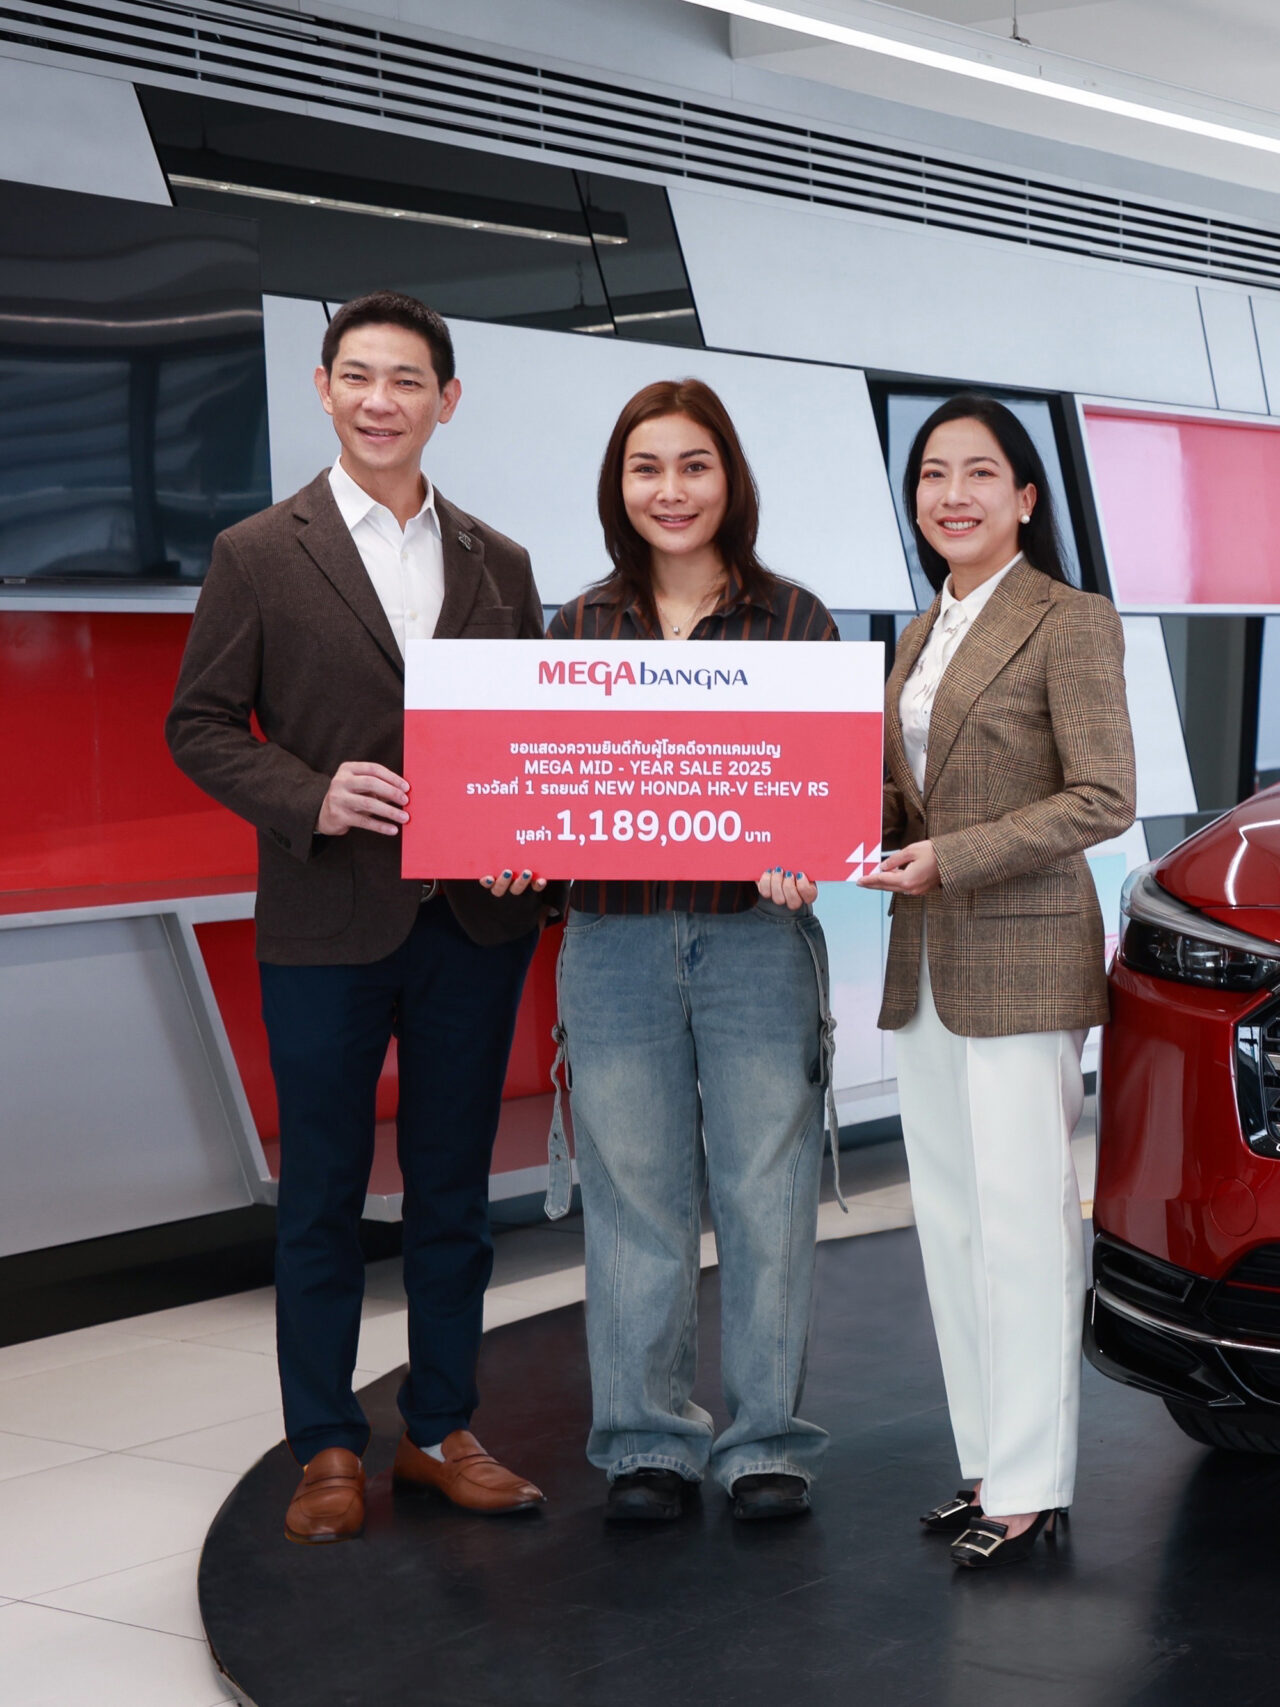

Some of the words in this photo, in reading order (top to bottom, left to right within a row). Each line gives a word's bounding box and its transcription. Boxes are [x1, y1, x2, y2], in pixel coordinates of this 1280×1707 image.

[538, 660, 636, 697] MEGA
[510, 738, 781, 760] ขอแสดงความยินดีกับผู้โชคดีจากแคมเปญ
[524, 759, 574, 776] MEGA
[579, 759, 613, 776] MID
[629, 759, 674, 776] YEAR
[679, 760, 723, 777] SALE
[727, 760, 772, 777] 2025
[466, 776, 519, 796] รางวัลที่
[525, 779, 535, 796] 1
[540, 778, 590, 796] รถยนต์
[594, 780, 635, 797] NEW
[640, 780, 702, 797] HONDA
[707, 780, 749, 797] HR-V
[753, 781, 803, 797] E:HEV
[807, 781, 829, 797] RS
[515, 826, 553, 846] มูลค่า
[556, 809, 743, 848] 1,189,000
[744, 832, 772, 845] บาท
